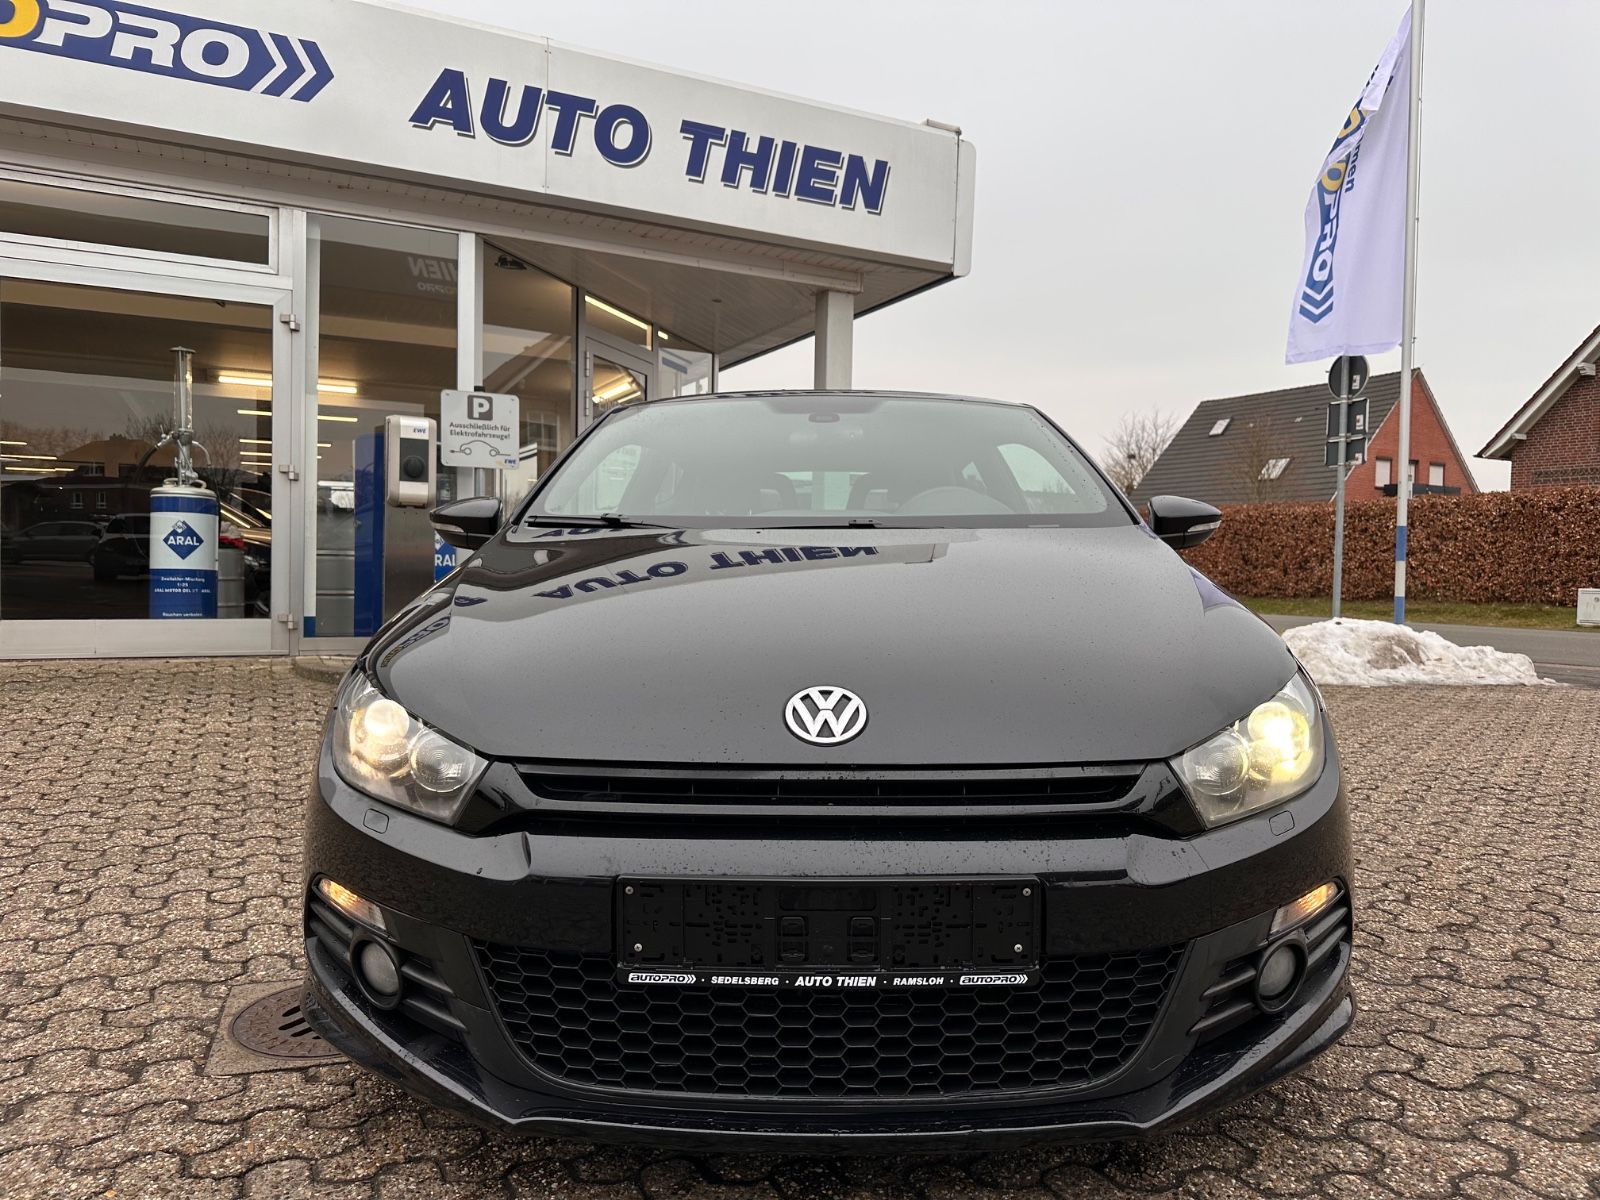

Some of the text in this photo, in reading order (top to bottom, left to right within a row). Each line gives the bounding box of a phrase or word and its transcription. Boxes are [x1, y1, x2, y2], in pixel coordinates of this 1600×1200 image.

[408, 68, 890, 215] AUTO THIEN
[473, 397, 490, 418] P
[449, 422, 499, 431] Ausschließlich
[450, 430, 511, 440] Elektrofahrzeuge!
[168, 536, 200, 546] ARAL
[786, 686, 867, 743] VW
[711, 976, 779, 985] SEDELSBERG
[795, 976, 832, 986] AUTO
[837, 976, 877, 987] THIEN
[893, 977, 944, 986] RAMSLOH
